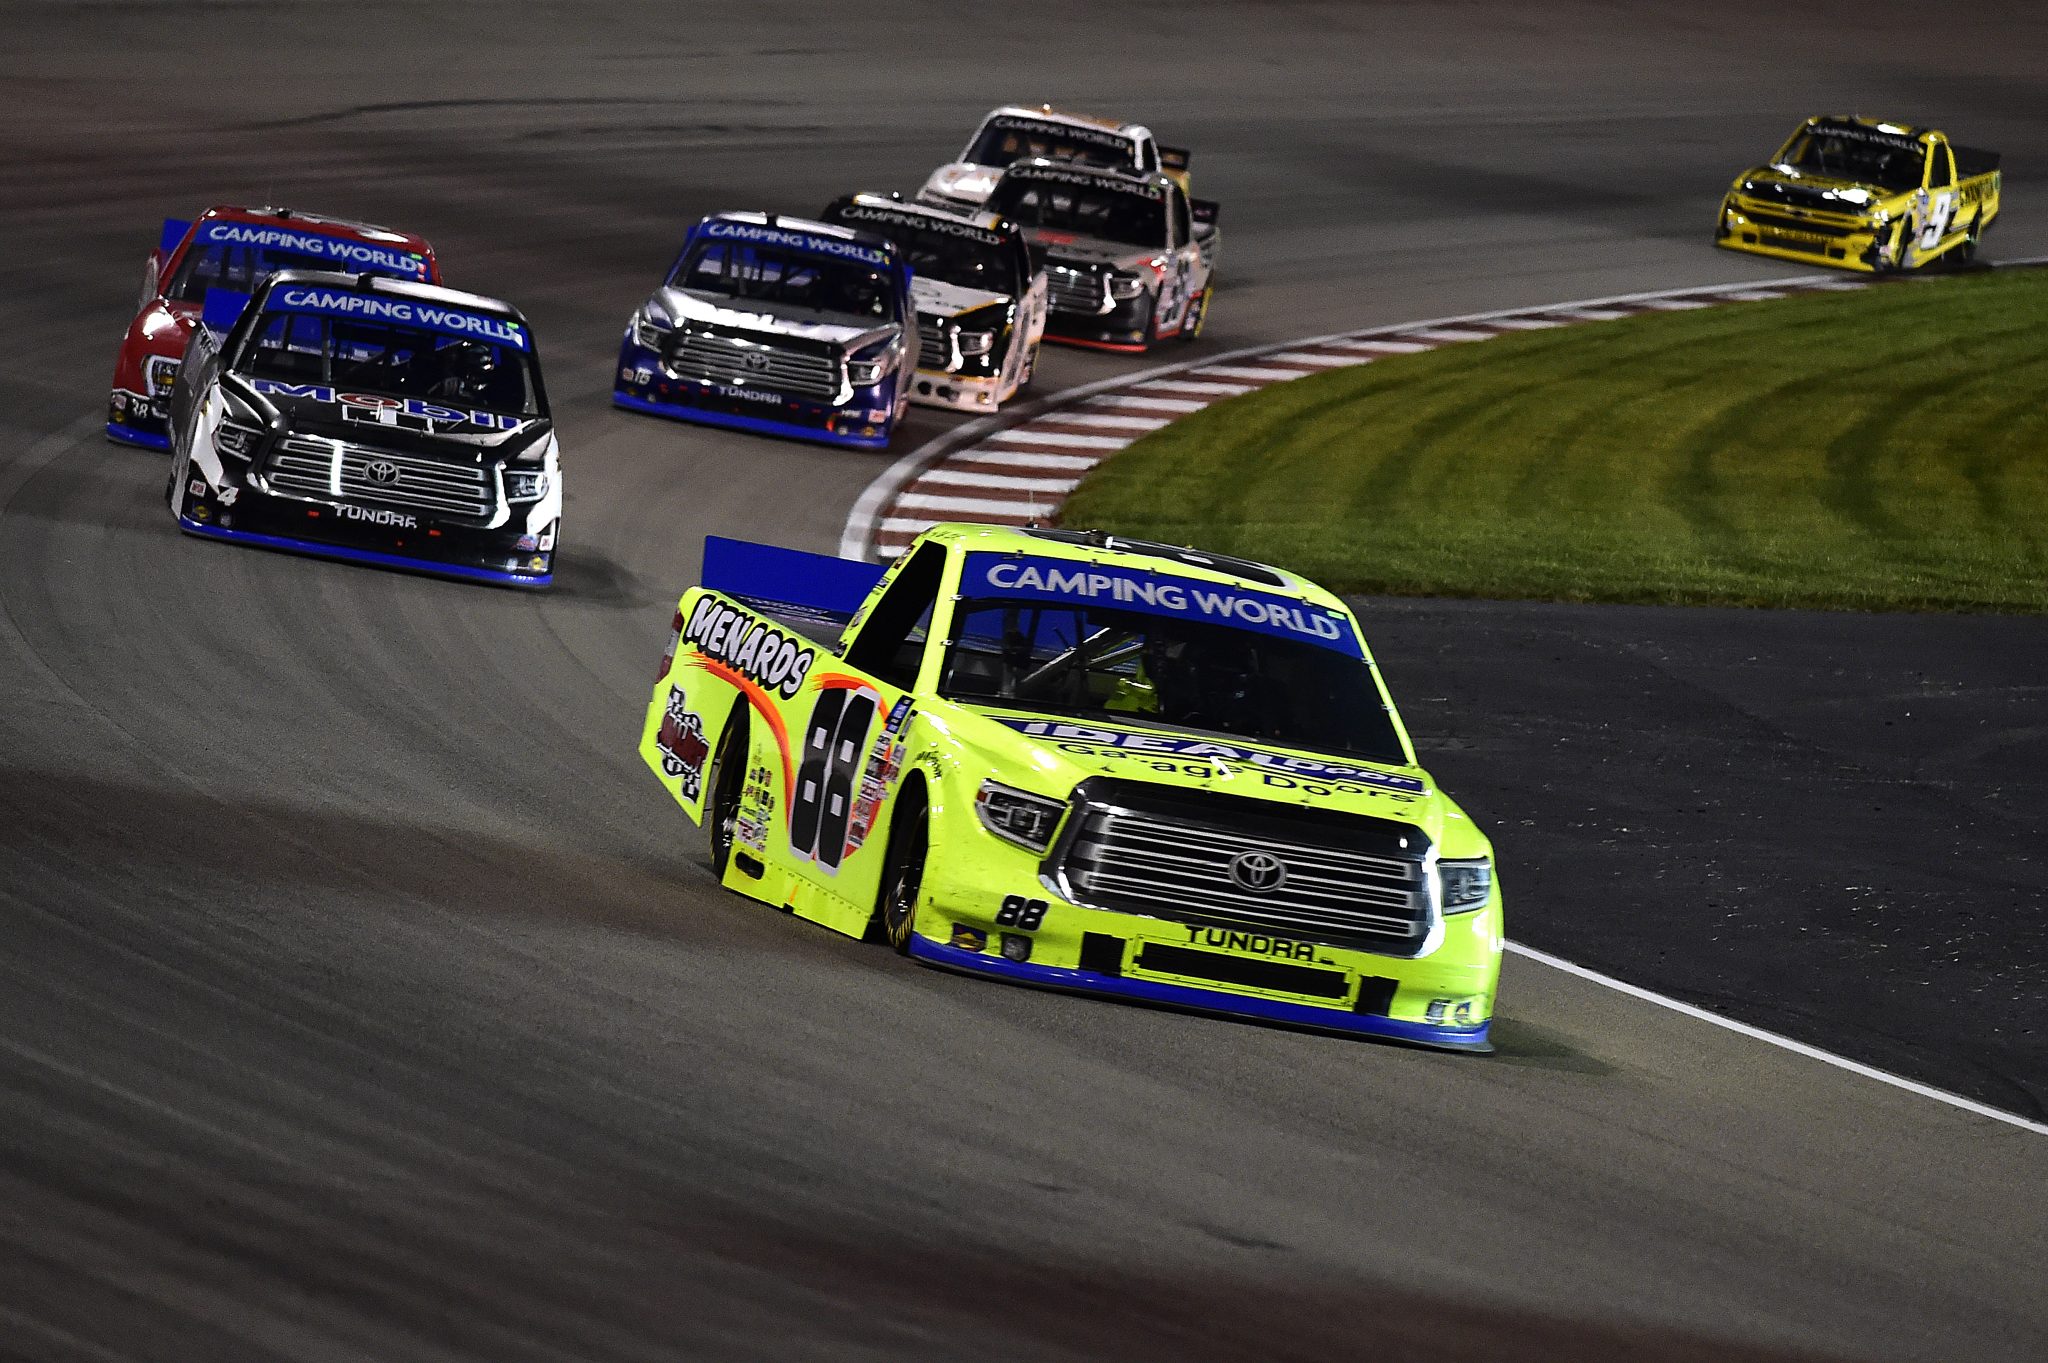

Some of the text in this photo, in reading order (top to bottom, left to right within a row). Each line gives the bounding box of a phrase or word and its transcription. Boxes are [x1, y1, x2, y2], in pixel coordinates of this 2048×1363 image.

[209, 225, 417, 272] CAMPING WORLD
[708, 223, 882, 264] CAMPING WORLD
[840, 207, 1000, 246] CAMPING WORLD
[284, 290, 517, 341] CAMPING WORLD
[250, 379, 523, 430] Mobil
[718, 384, 783, 405] TUNDRA
[333, 504, 418, 529] TUNDRA
[986, 563, 1341, 640] CAMPING WORLD
[683, 594, 815, 700] MENARDS
[789, 686, 881, 876] 88
[1058, 744, 1416, 803] Gaage Doors
[996, 894, 1049, 932] 88
[1184, 923, 1315, 962] TUNDRA
